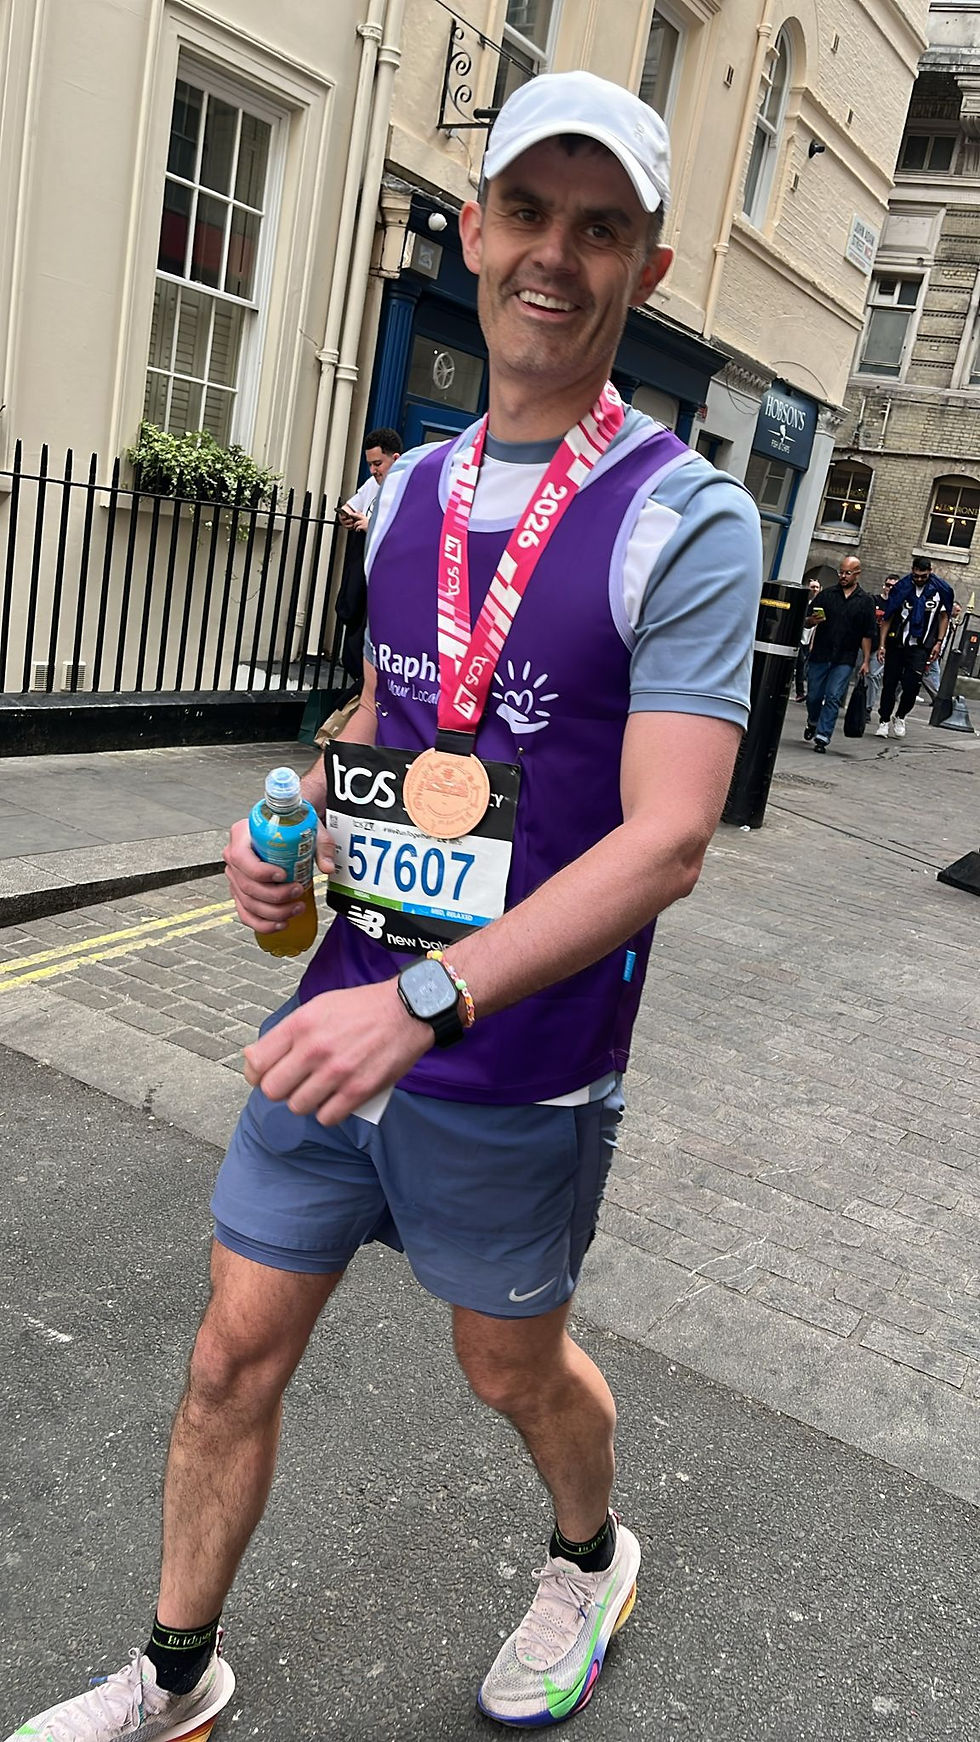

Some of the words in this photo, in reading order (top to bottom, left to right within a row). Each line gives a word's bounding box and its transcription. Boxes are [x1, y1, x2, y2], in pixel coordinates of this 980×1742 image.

[765, 395, 806, 431] HOBSON'S
[517, 482, 568, 548] 2026
[447, 565, 460, 596] tcs
[378, 643, 441, 684] Raph
[464, 656, 491, 686] tcs
[332, 753, 397, 809] tcs
[348, 833, 476, 901] 57607
[386, 932, 416, 948] new
